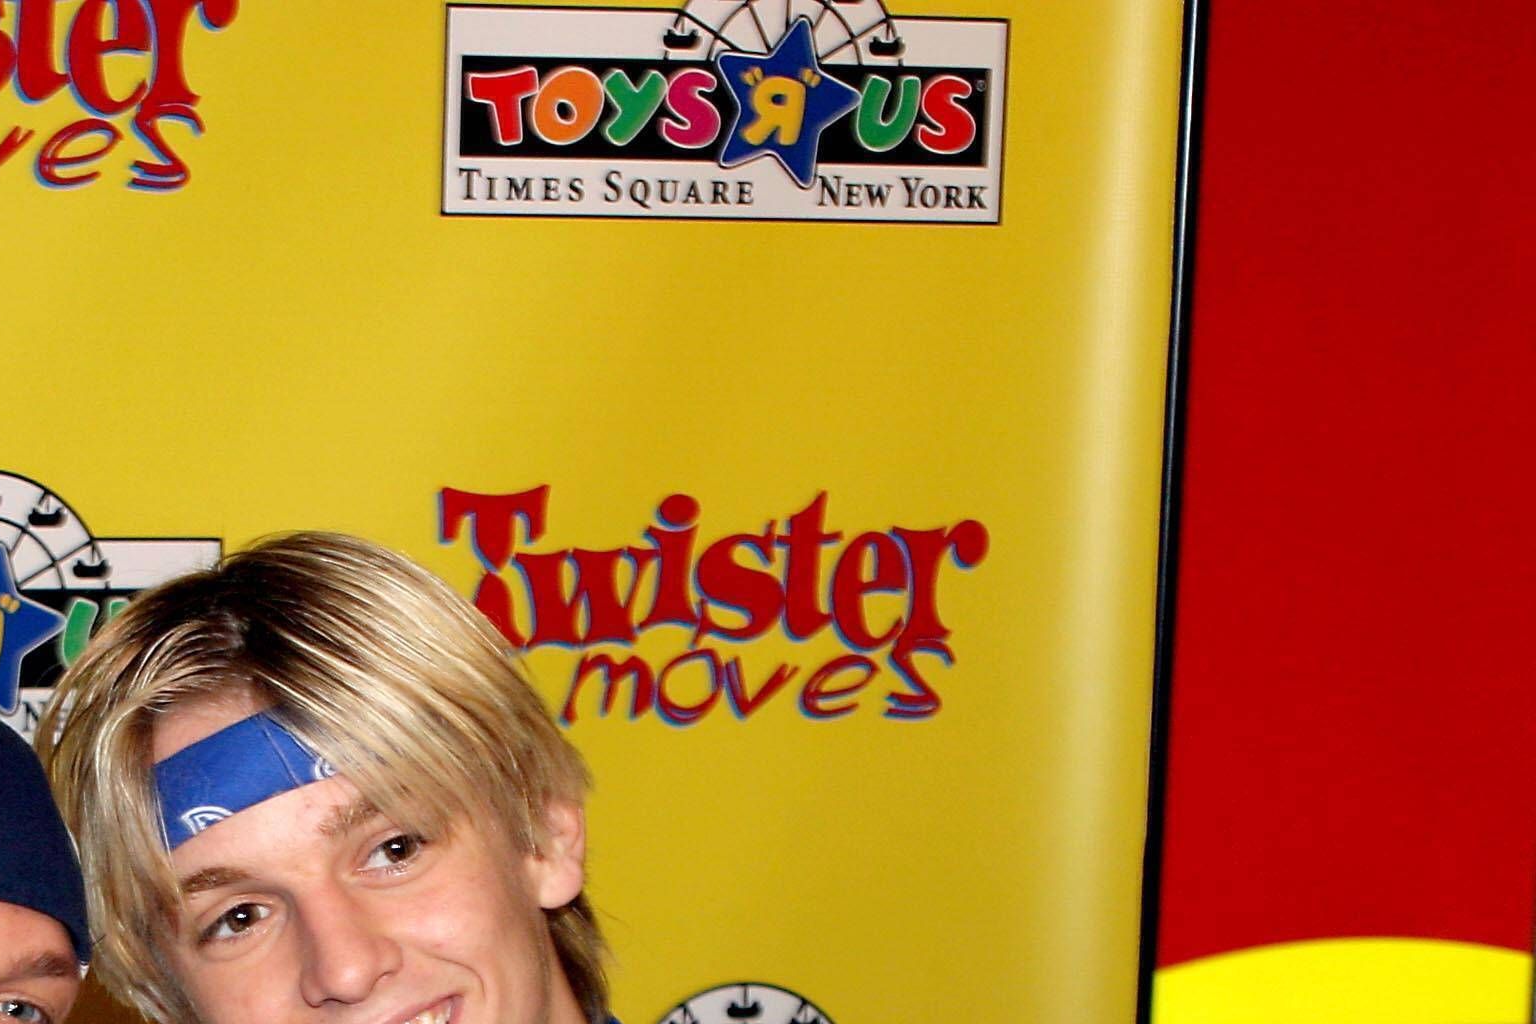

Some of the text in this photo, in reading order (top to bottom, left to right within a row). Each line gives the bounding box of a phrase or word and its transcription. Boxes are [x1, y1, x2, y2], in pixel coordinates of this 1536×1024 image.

[467, 67, 722, 149] TOYS
[857, 74, 978, 154] US
[458, 167, 989, 210] TIMES SQUARE NEW YORK
[437, 484, 991, 653] Twister
[559, 638, 957, 727] moves
